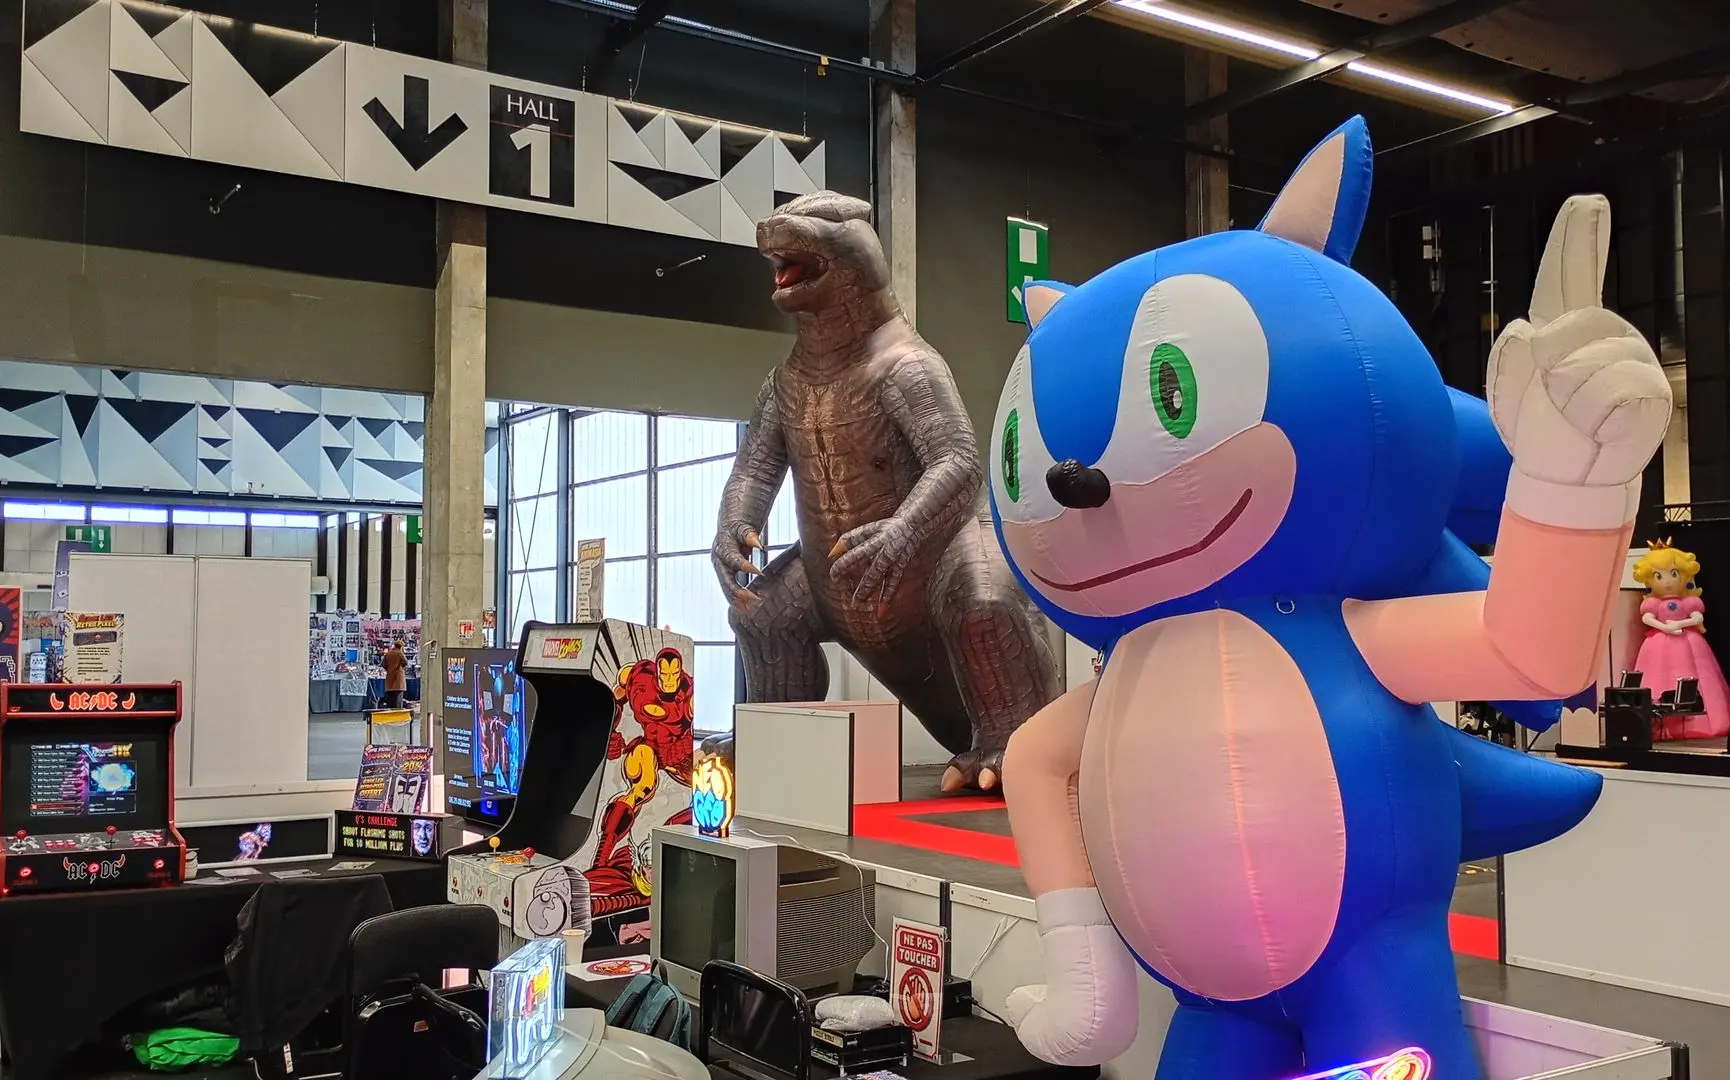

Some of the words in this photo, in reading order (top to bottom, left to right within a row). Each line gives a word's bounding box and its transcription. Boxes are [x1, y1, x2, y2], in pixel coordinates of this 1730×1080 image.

[507, 94, 559, 121] HALL
[510, 123, 550, 198] 1
[558, 639, 582, 660] COMICS
[693, 760, 725, 801] NEO
[693, 790, 724, 828] GEO
[367, 815, 398, 827] CHALLENGE
[342, 826, 358, 836] SHOOT
[360, 827, 386, 839] FLASHING
[388, 830, 405, 840] SHOTS
[343, 838, 354, 848] FOR
[356, 838, 363, 848] 10
[365, 839, 388, 850] MILLION
[389, 841, 404, 852] PLUS
[903, 933, 915, 946] NE
[917, 935, 933, 950] PAS
[899, 948, 937, 969] TOUCHER
